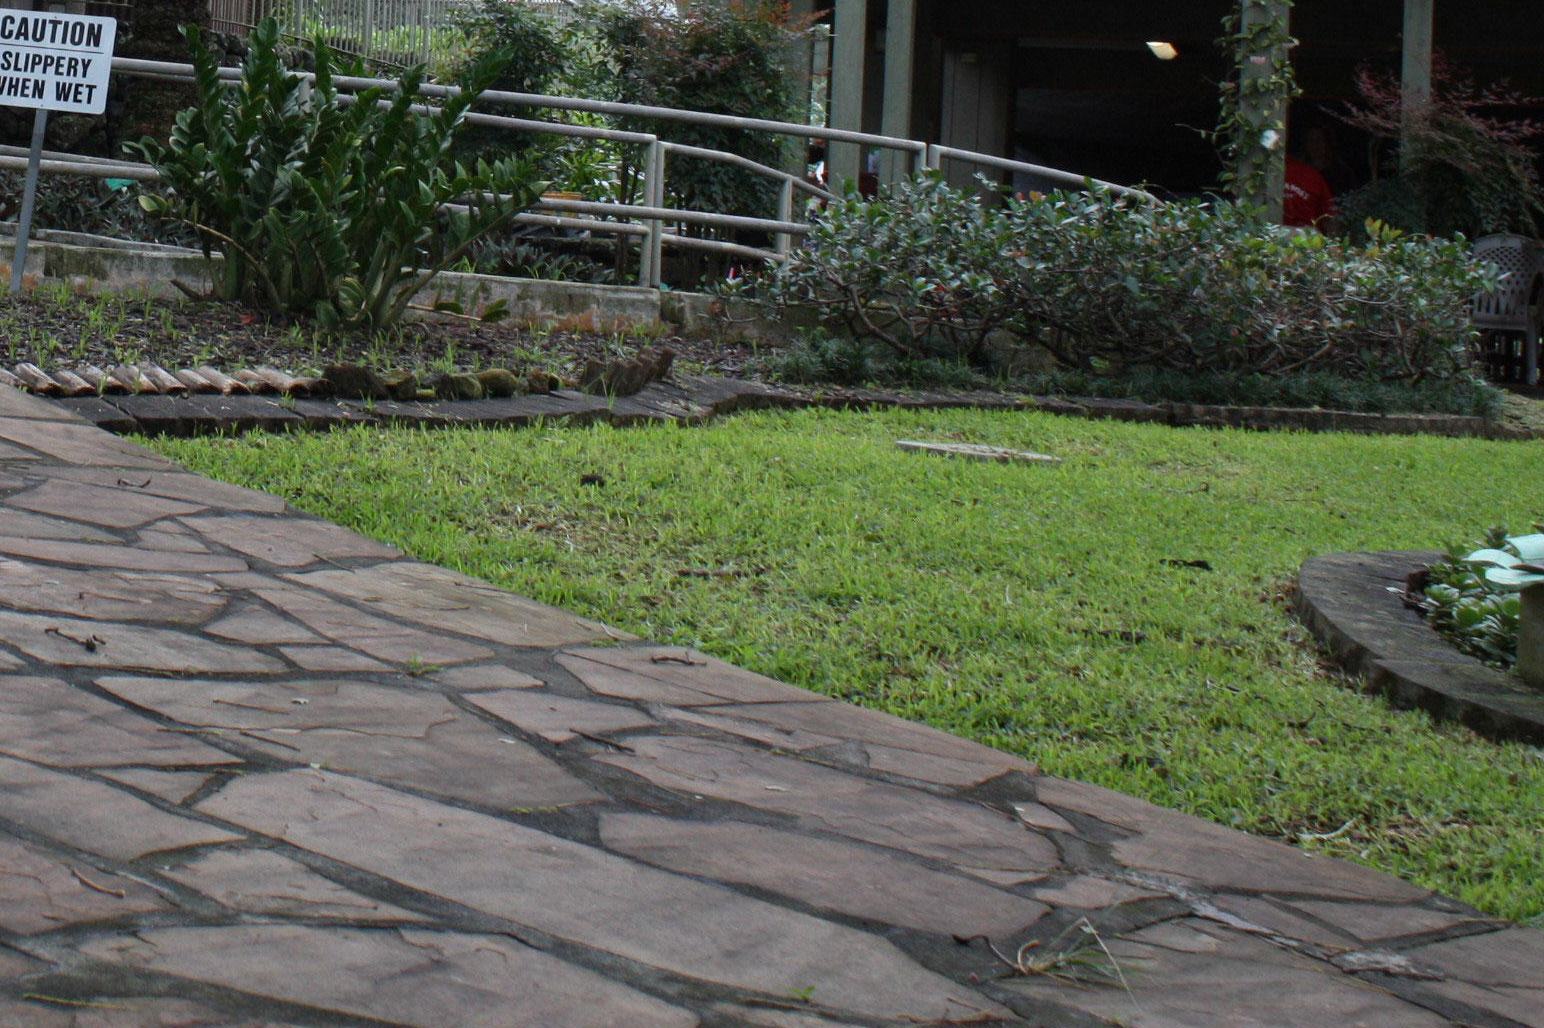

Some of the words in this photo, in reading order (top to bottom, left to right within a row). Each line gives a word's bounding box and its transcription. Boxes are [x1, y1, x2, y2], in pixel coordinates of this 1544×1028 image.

[0, 15, 102, 47] CAUTION
[0, 50, 91, 77] SLIPPERY
[55, 81, 96, 104] WET
